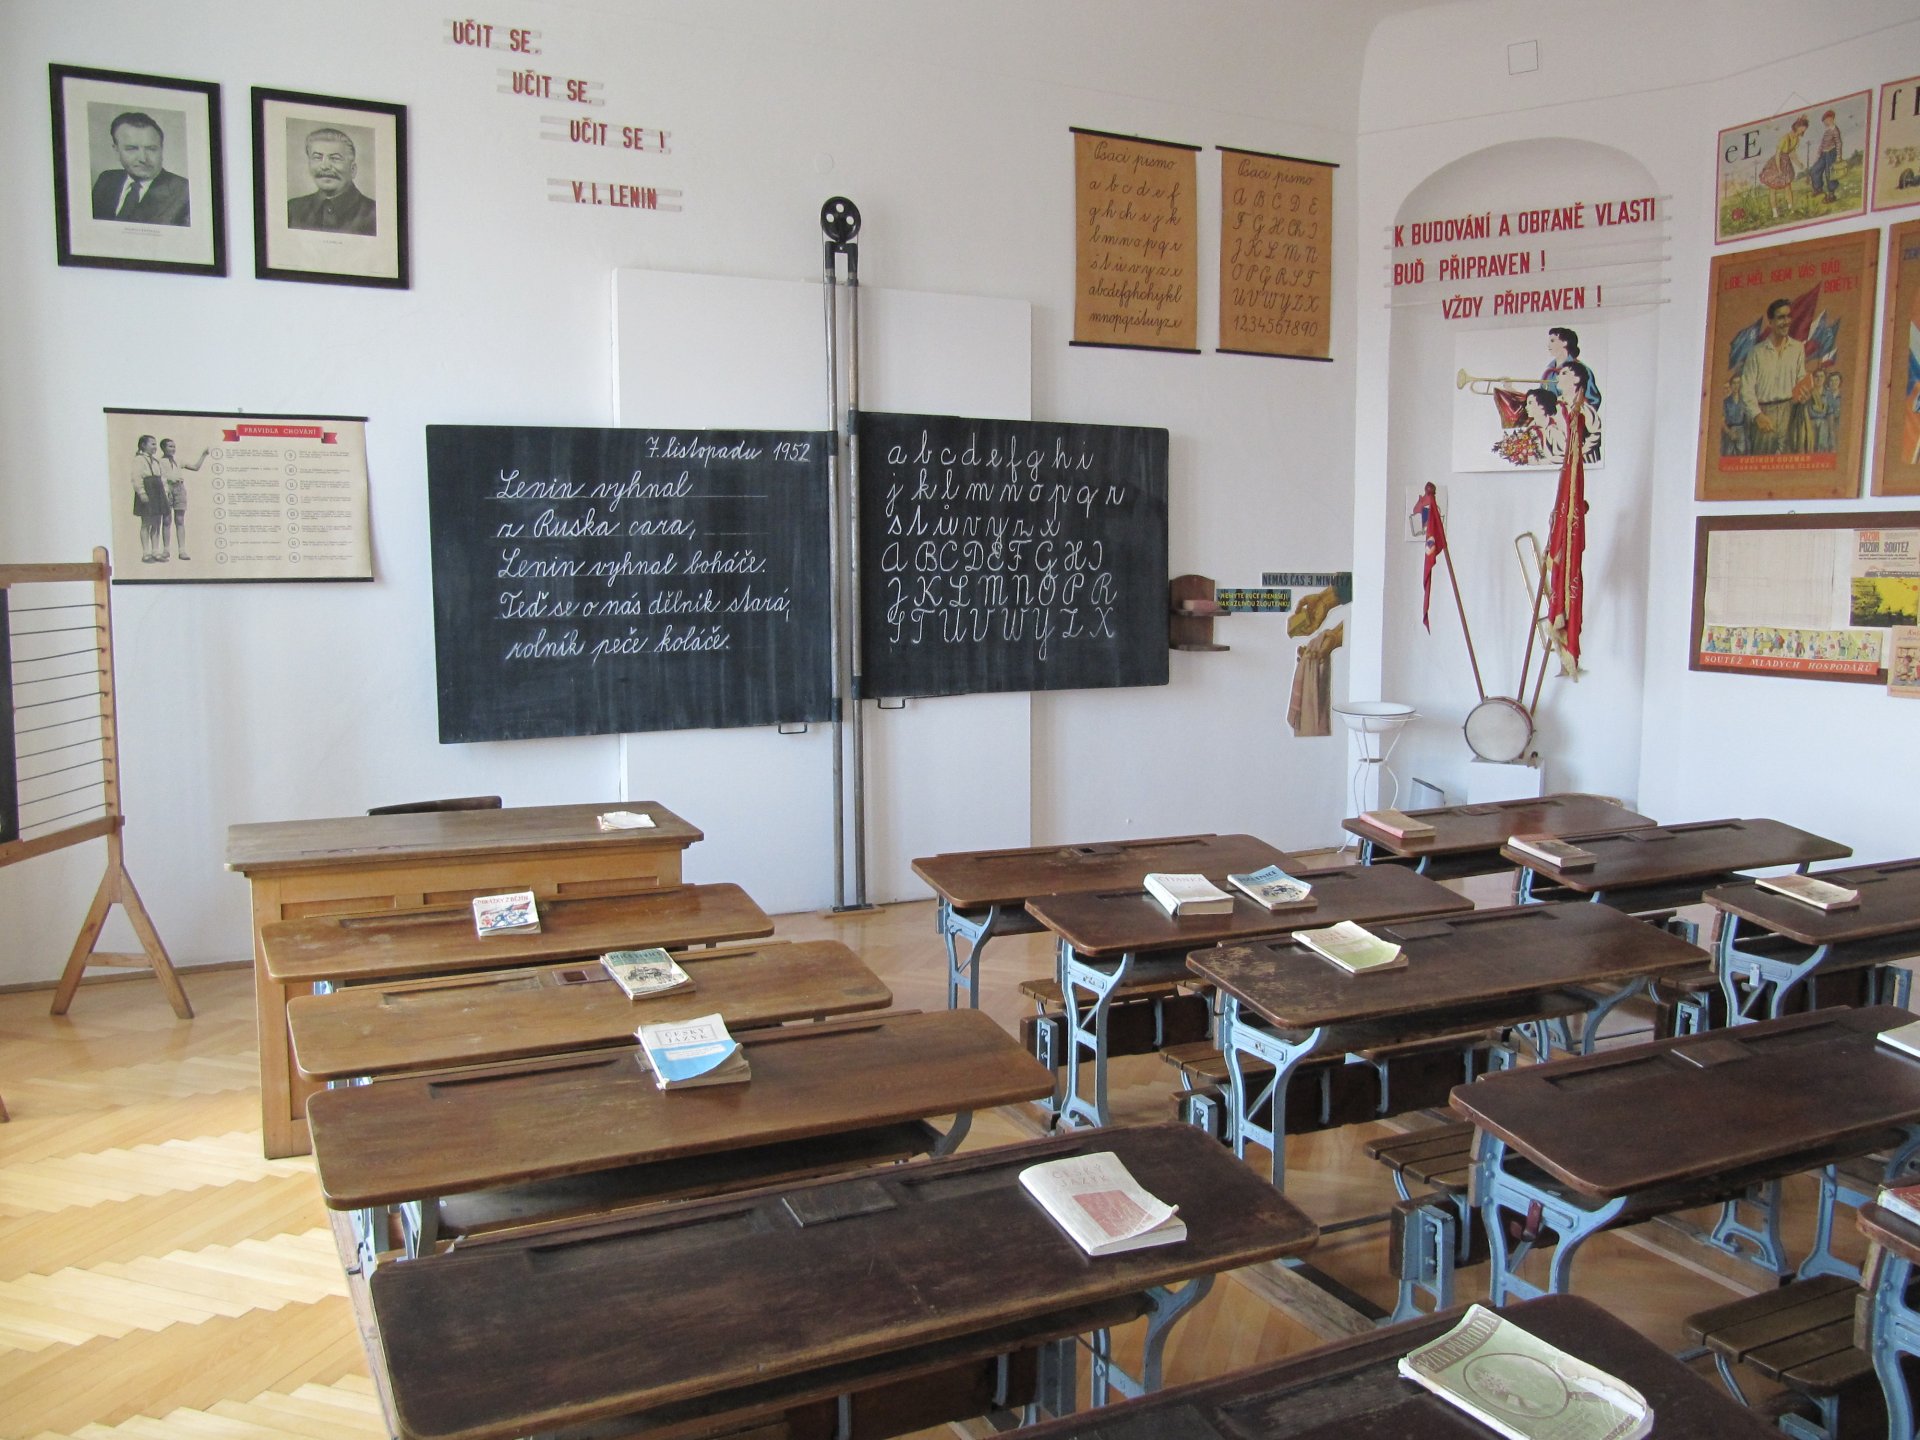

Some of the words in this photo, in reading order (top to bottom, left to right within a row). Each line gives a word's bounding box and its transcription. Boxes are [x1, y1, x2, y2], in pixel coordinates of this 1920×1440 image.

[453, 19, 493, 48] UČIT
[513, 70, 552, 98] UČIT
[570, 117, 607, 146] UČIT
[623, 127, 643, 150] SE
[609, 184, 657, 209] LENIN
[1395, 225, 1404, 247] K
[1412, 212, 1490, 246] BUDOVÁNÍ
[1499, 214, 1510, 237] A
[1518, 202, 1584, 233] OBRANĚ
[1595, 198, 1655, 226] VLASTI
[1394, 259, 1424, 285] BUĎ
[1440, 251, 1530, 281] PŘIPRAVEN
[1442, 291, 1483, 320] VŽDY
[1494, 287, 1584, 316] PŘIPRAVEN
[773, 442, 810, 461] 1952
[888, 445, 907, 464] a
[914, 430, 932, 464] b
[941, 448, 956, 464] c
[962, 433, 981, 466] d
[986, 449, 1003, 468] e
[1007, 436, 1021, 482] f
[1027, 450, 1044, 481] g
[1052, 437, 1072, 469] h
[1076, 442, 1093, 469] i
[496, 469, 585, 499] Lenin
[591, 470, 693, 512] vyhnal
[886, 473, 903, 517] j
[912, 468, 937, 501] k
[941, 469, 959, 500] l
[966, 482, 994, 500] m
[1000, 484, 1023, 502] n
[1029, 484, 1044, 502] o
[1048, 483, 1071, 519] p
[1077, 486, 1098, 518] q
[534, 508, 620, 537] Ruska
[629, 520, 696, 540] cara,
[499, 548, 585, 578] Lenin
[588, 552, 677, 587] vyhnal
[683, 550, 766, 574] boháče.
[882, 542, 908, 572] A
[915, 541, 937, 572] B
[940, 541, 958, 572] C
[964, 541, 983, 572] D
[987, 541, 1004, 571] E
[1008, 540, 1032, 572] F
[1035, 541, 1057, 590] G
[1065, 541, 1086, 572] H
[1308, 576, 1312, 585] 3
[500, 590, 549, 619] Teď
[548, 602, 579, 617] se
[583, 602, 600, 617] o
[600, 593, 640, 616] nás
[649, 590, 720, 615] dělník
[726, 585, 790, 622] stará,
[888, 577, 908, 622] J
[914, 576, 942, 607] K
[950, 575, 970, 607] L
[978, 575, 1008, 606] M
[1012, 575, 1033, 606] N
[1039, 574, 1058, 605] O
[1063, 573, 1084, 604] P
[1091, 573, 1117, 604] R
[505, 628, 585, 659] rolník
[591, 628, 648, 666] peče
[654, 626, 730, 652] koláče.
[911, 609, 935, 643] T
[939, 609, 967, 643] U
[970, 609, 995, 642] V
[1001, 608, 1029, 641] W
[1033, 608, 1055, 660] Y
[1090, 607, 1115, 638] X
